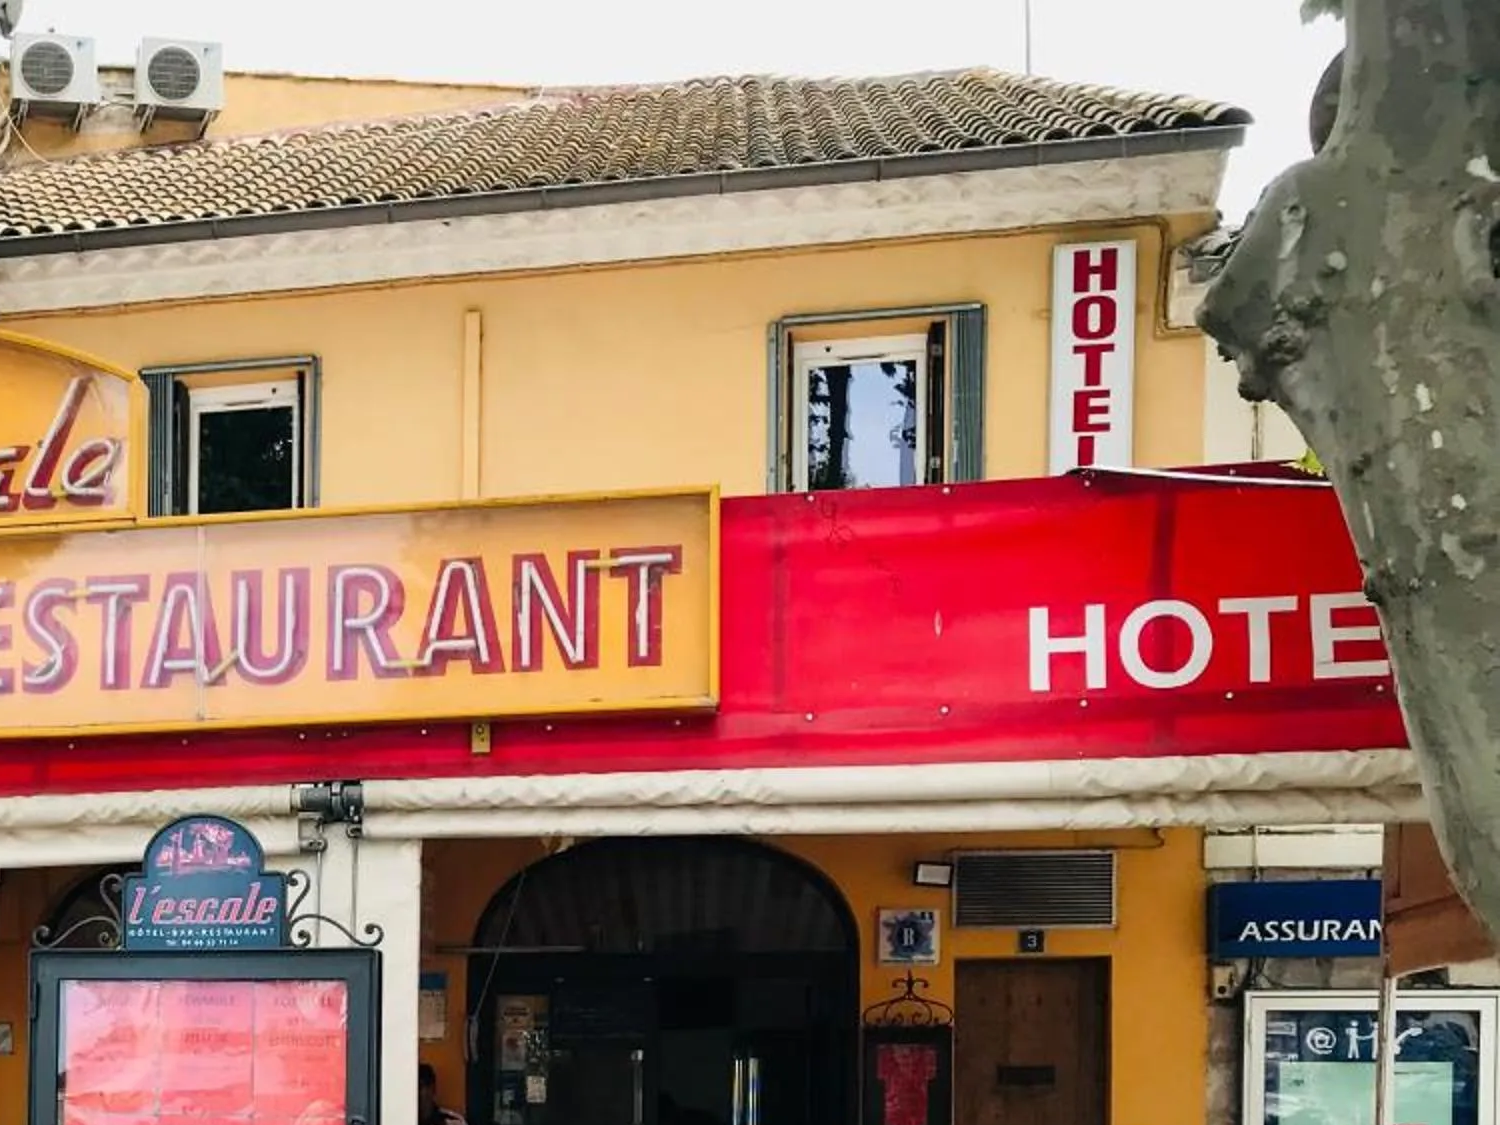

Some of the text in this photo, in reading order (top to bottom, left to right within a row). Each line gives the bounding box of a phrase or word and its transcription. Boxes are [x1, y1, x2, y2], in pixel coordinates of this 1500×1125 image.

[1071, 247, 1118, 467] HOTEL
[1028, 591, 1391, 692] HOTE
[128, 881, 277, 925] l'escale
[1028, 935, 1037, 948] 3
[1238, 919, 1383, 942] ASSURAN
